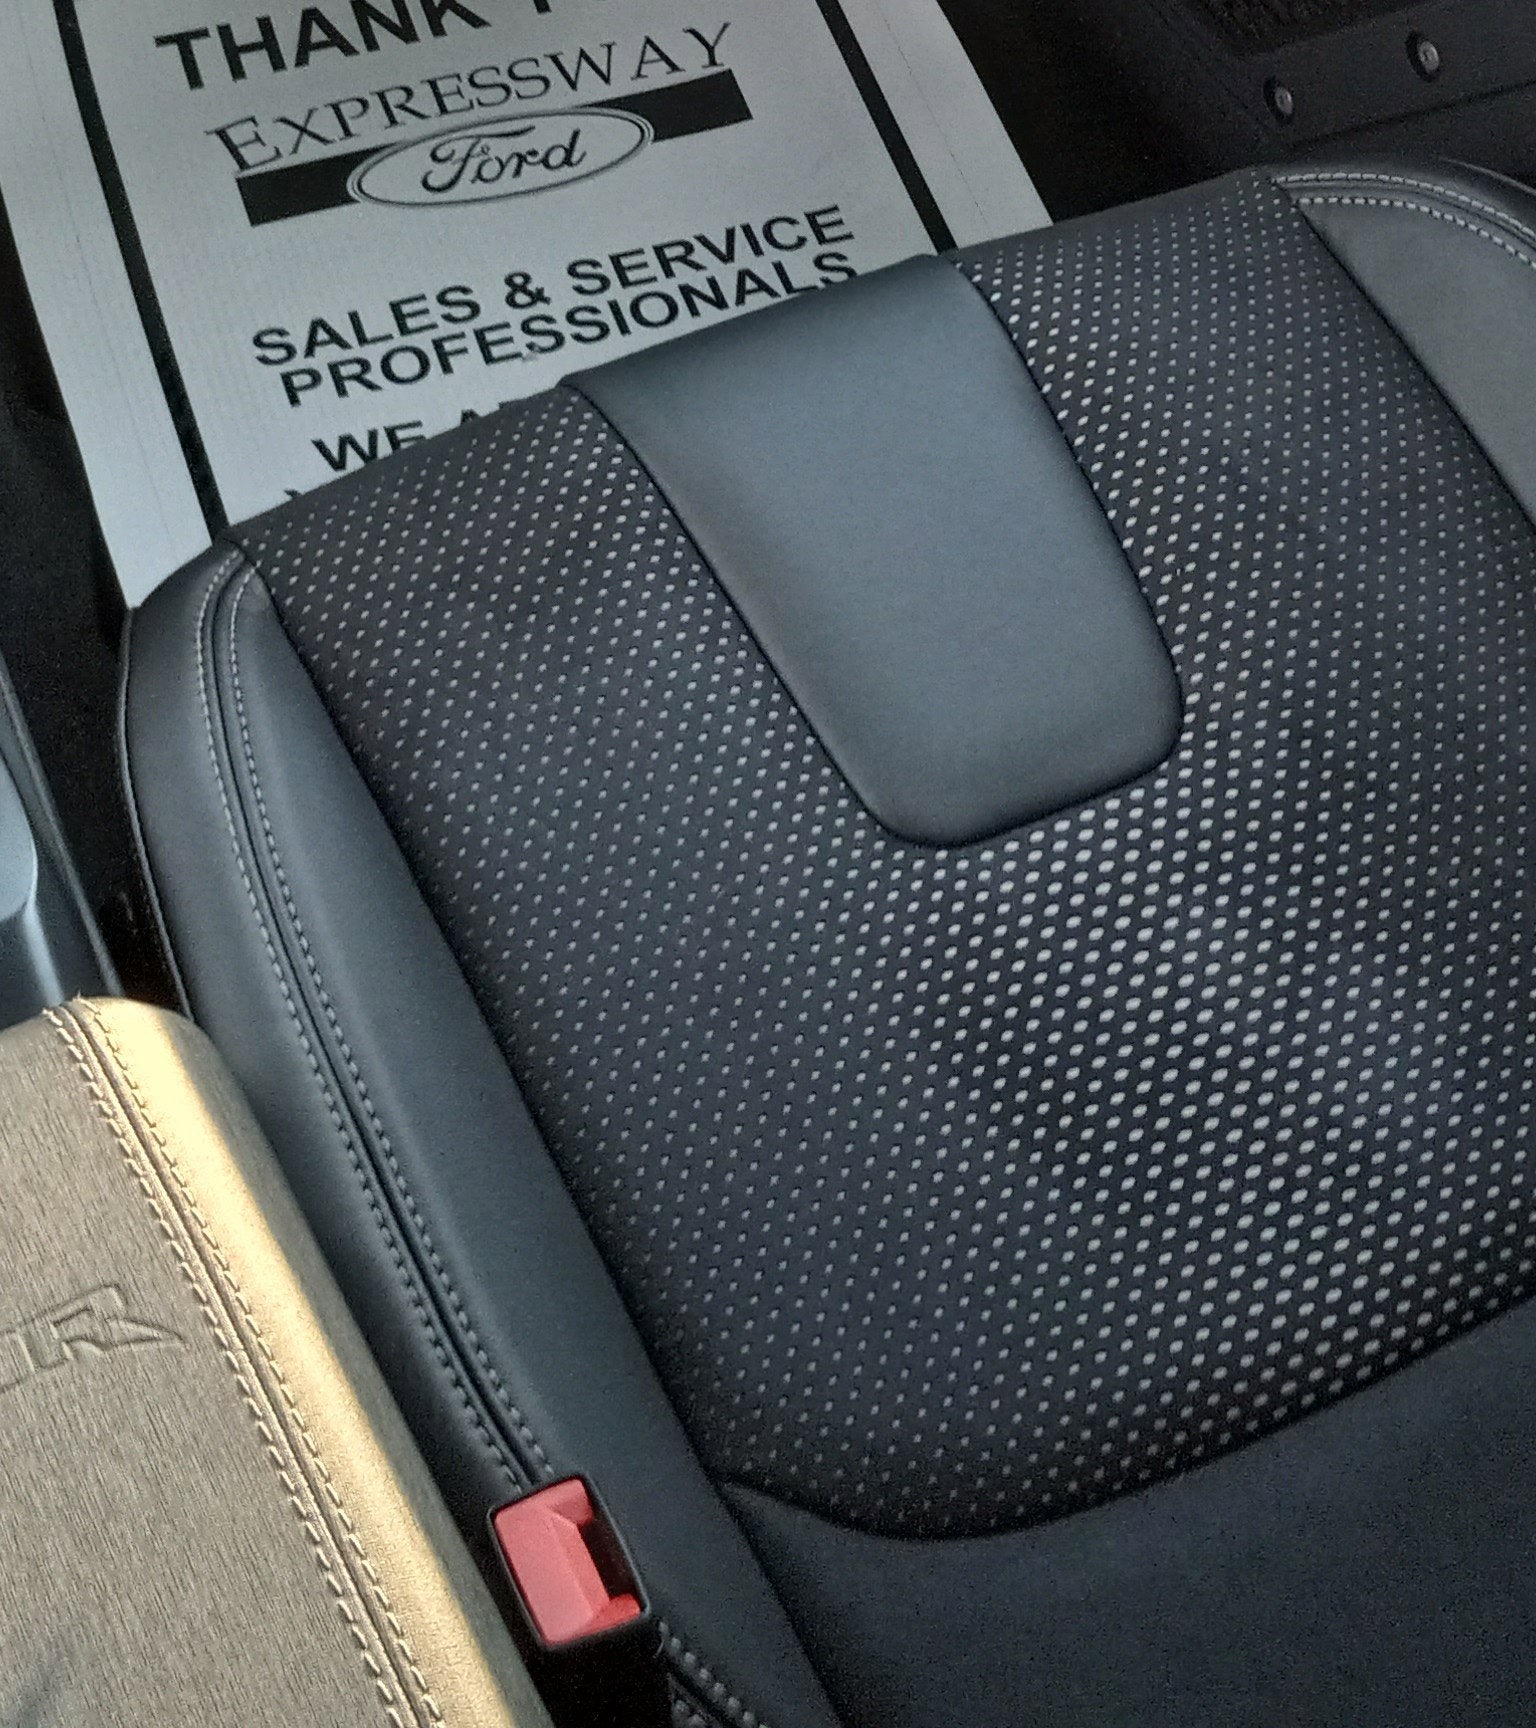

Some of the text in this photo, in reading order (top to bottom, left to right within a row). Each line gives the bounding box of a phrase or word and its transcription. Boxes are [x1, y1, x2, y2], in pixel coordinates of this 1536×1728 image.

[206, 22, 732, 171] EXPRESSWAY
[421, 127, 588, 193] Ford
[251, 205, 855, 368] SALES & SERVICE
[280, 252, 858, 408] PROFESSIONALS
